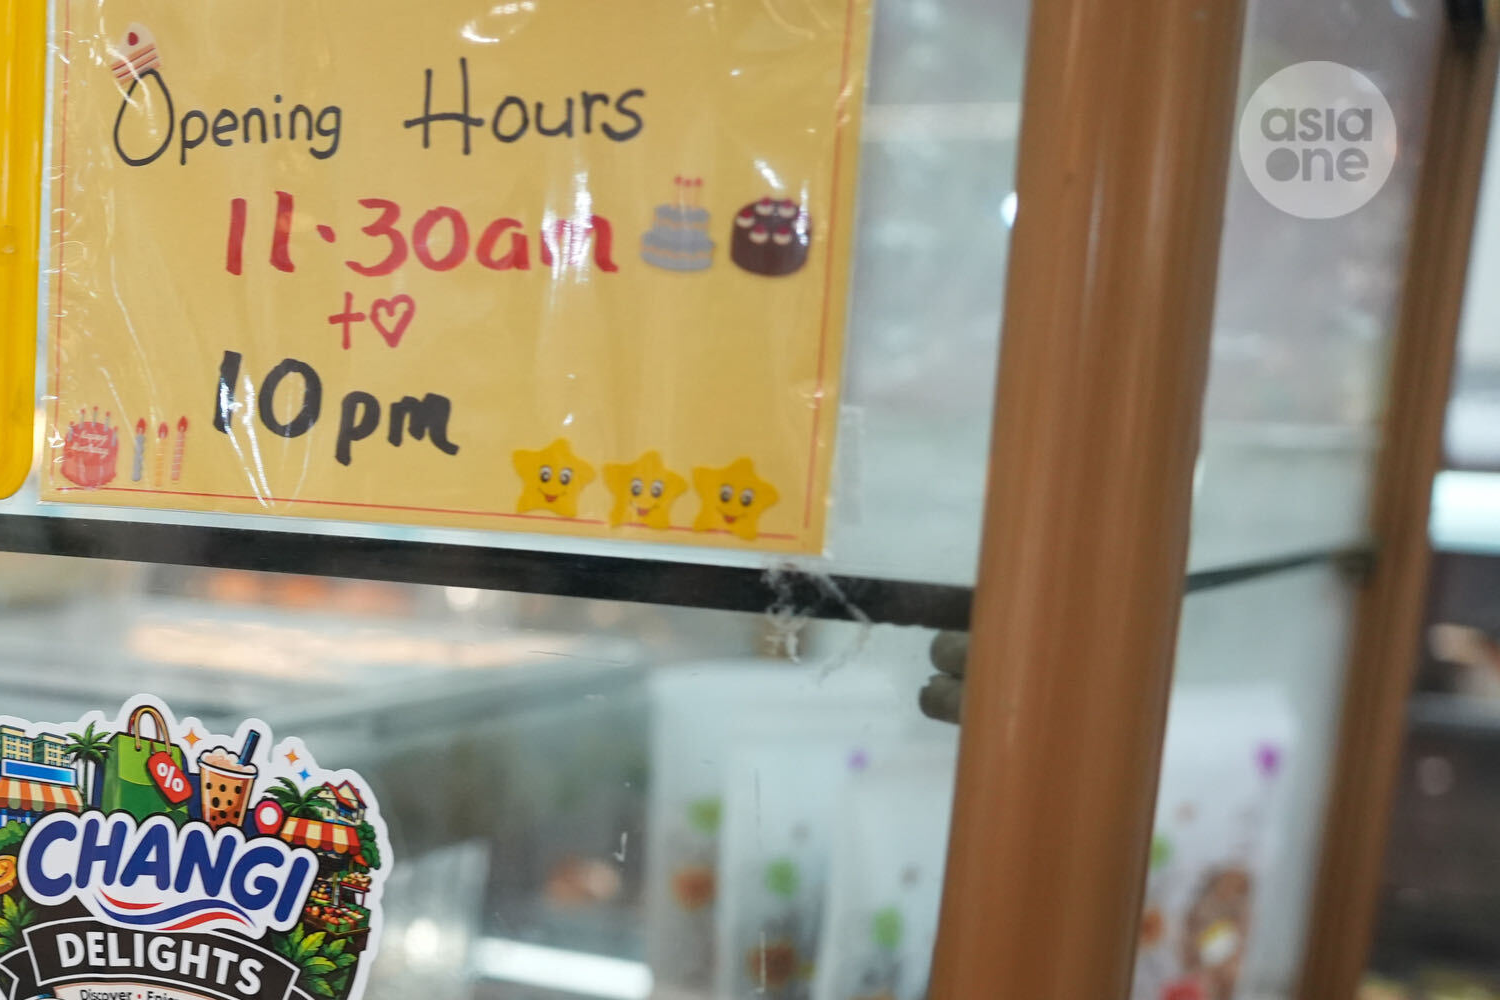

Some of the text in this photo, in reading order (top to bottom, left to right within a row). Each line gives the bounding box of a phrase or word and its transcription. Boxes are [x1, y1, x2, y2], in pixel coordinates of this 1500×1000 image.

[113, 57, 646, 166] Opening Hours
[25, 818, 310, 923] CHANGI
[56, 932, 263, 996] DELIGHTS
